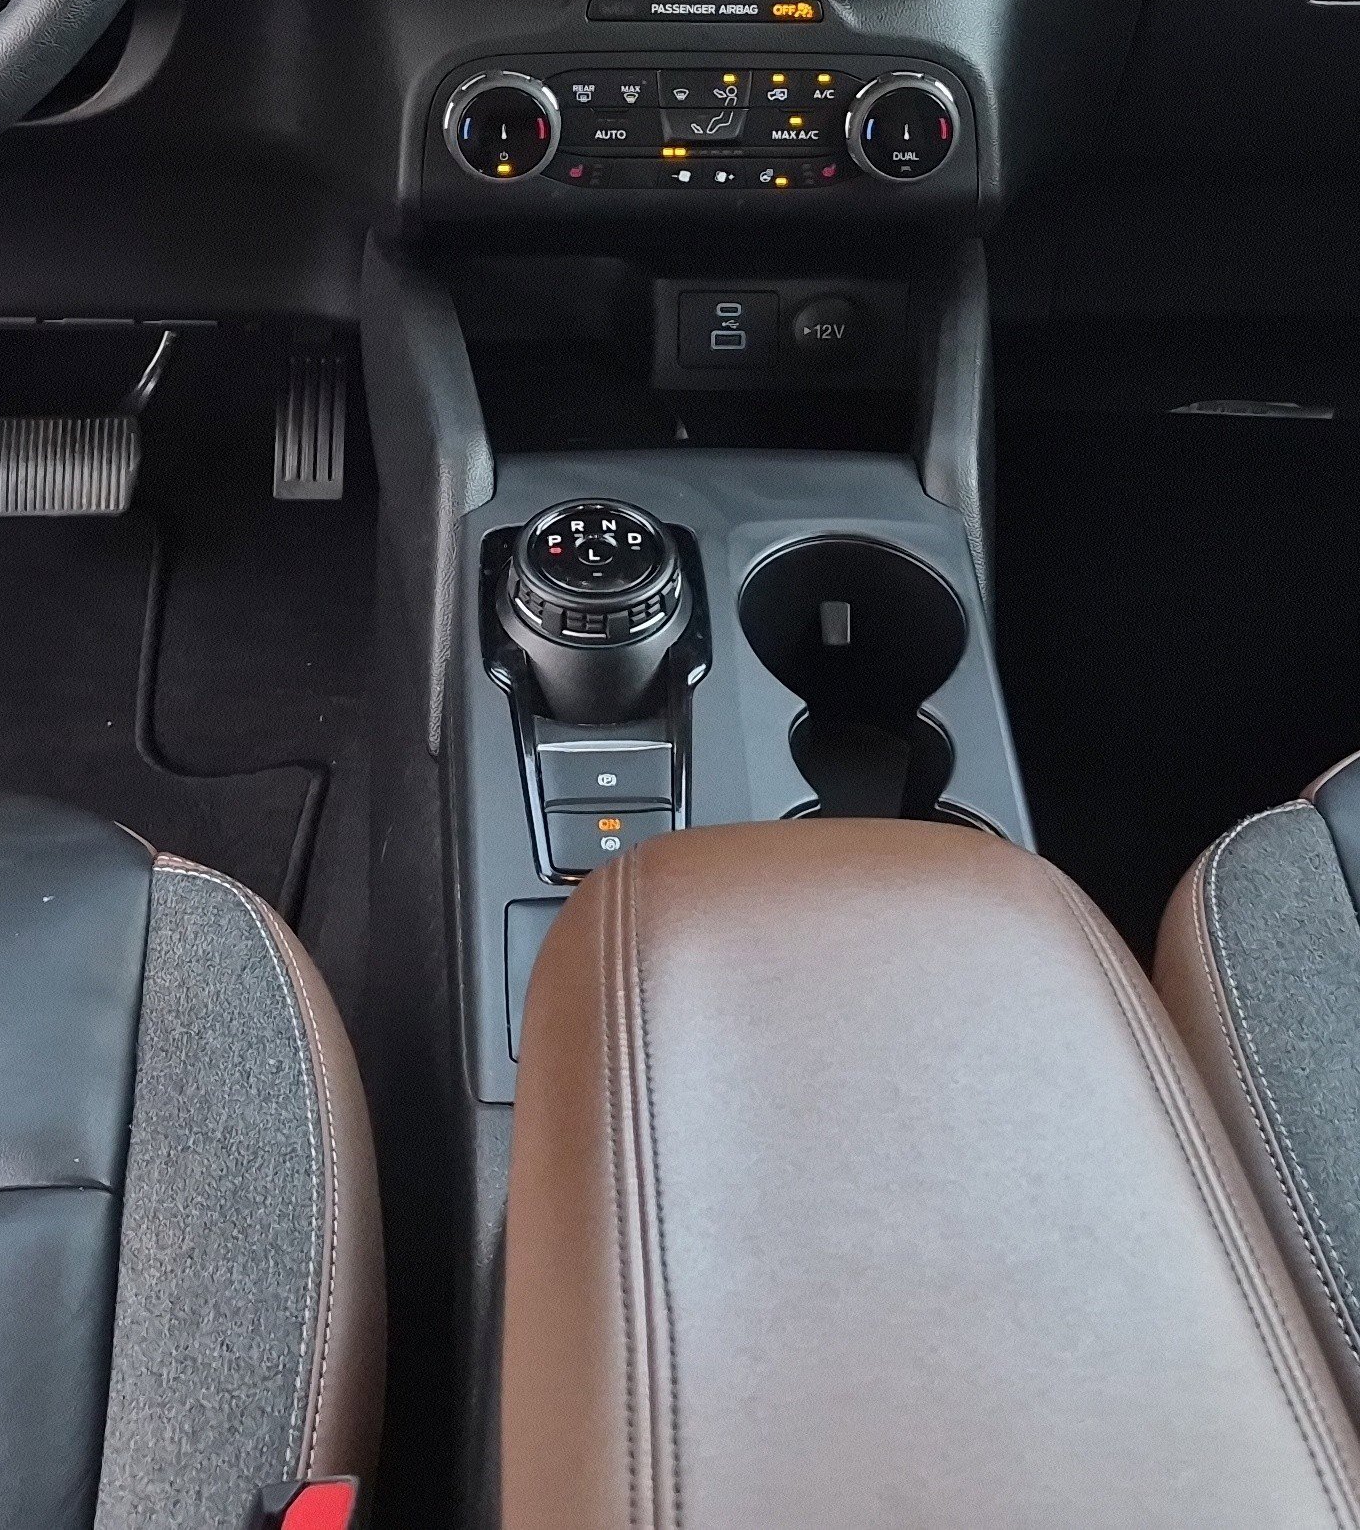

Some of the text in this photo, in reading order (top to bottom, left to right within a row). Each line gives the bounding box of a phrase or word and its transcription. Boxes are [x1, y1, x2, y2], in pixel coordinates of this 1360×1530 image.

[651, 3, 796, 16] PASSENGER AIRBAG OFF
[573, 84, 596, 93] REAR
[620, 85, 641, 93] MAX
[813, 88, 835, 100] A/C
[594, 129, 627, 140] AUTO
[772, 130, 820, 141] MAX A/C
[892, 152, 920, 161] DUAL
[814, 324, 845, 339] 12V
[570, 520, 617, 532] R N
[547, 535, 562, 547] P
[627, 532, 642, 544] D
[588, 548, 601, 561] L
